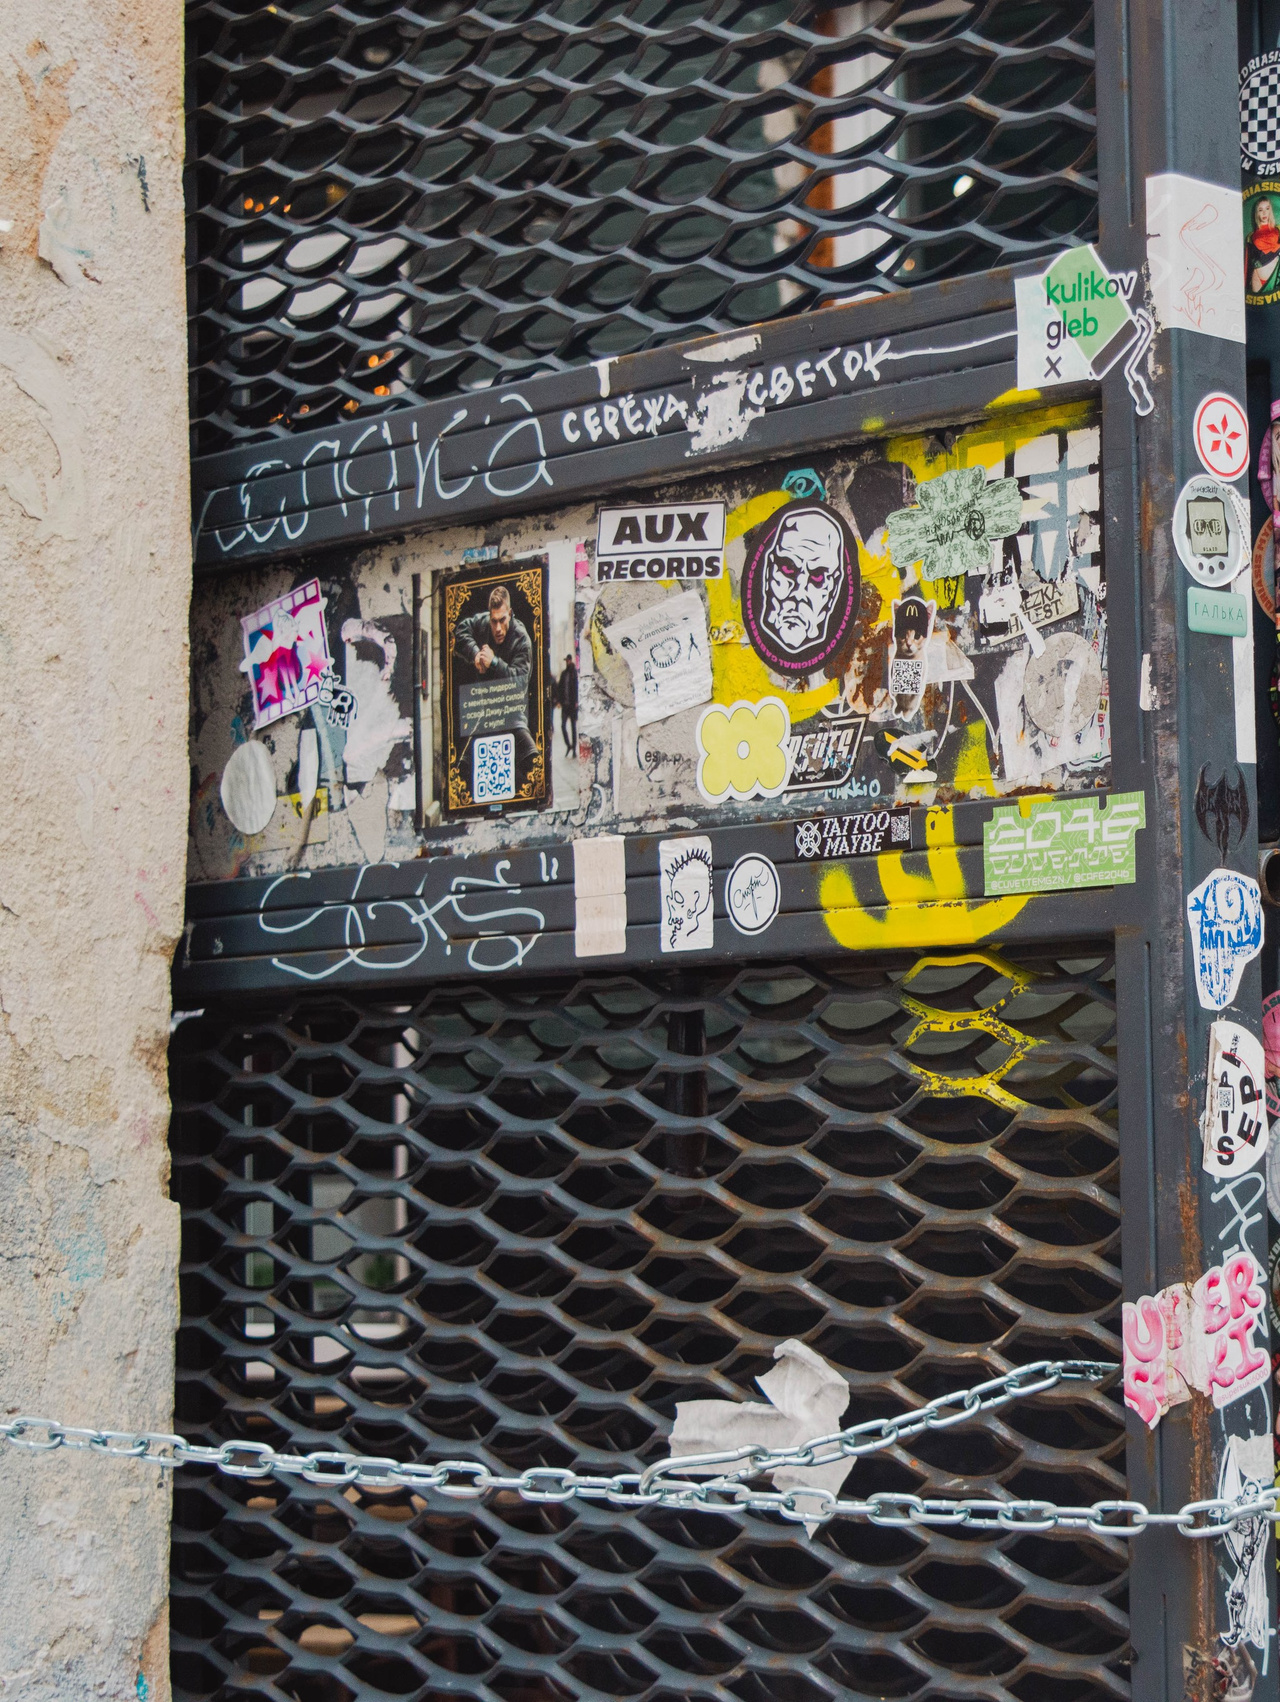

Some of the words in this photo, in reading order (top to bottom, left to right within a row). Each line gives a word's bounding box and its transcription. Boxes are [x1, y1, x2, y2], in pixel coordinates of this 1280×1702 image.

[1046, 271, 1135, 306] kulikov
[1046, 309, 1099, 349] gleb
[611, 511, 709, 545] AUX
[599, 556, 721, 580] RECORDS
[746, 543, 765, 619] HARDCORE
[836, 564, 854, 641] GUARDIAN
[1194, 601, 1245, 622] ГАЛЬКА
[779, 651, 827, 670] ORIGINAL
[826, 640, 838, 656] OF
[489, 682, 517, 693] лидером
[822, 811, 890, 838] TATTOO
[989, 802, 1140, 853] 2046
[823, 832, 885, 858] MAYBE
[991, 876, 1065, 891] @CUVETTEMGZN
[1073, 870, 1130, 884] @CAFE2046
[1217, 1367, 1269, 1406] @supersuki6000
